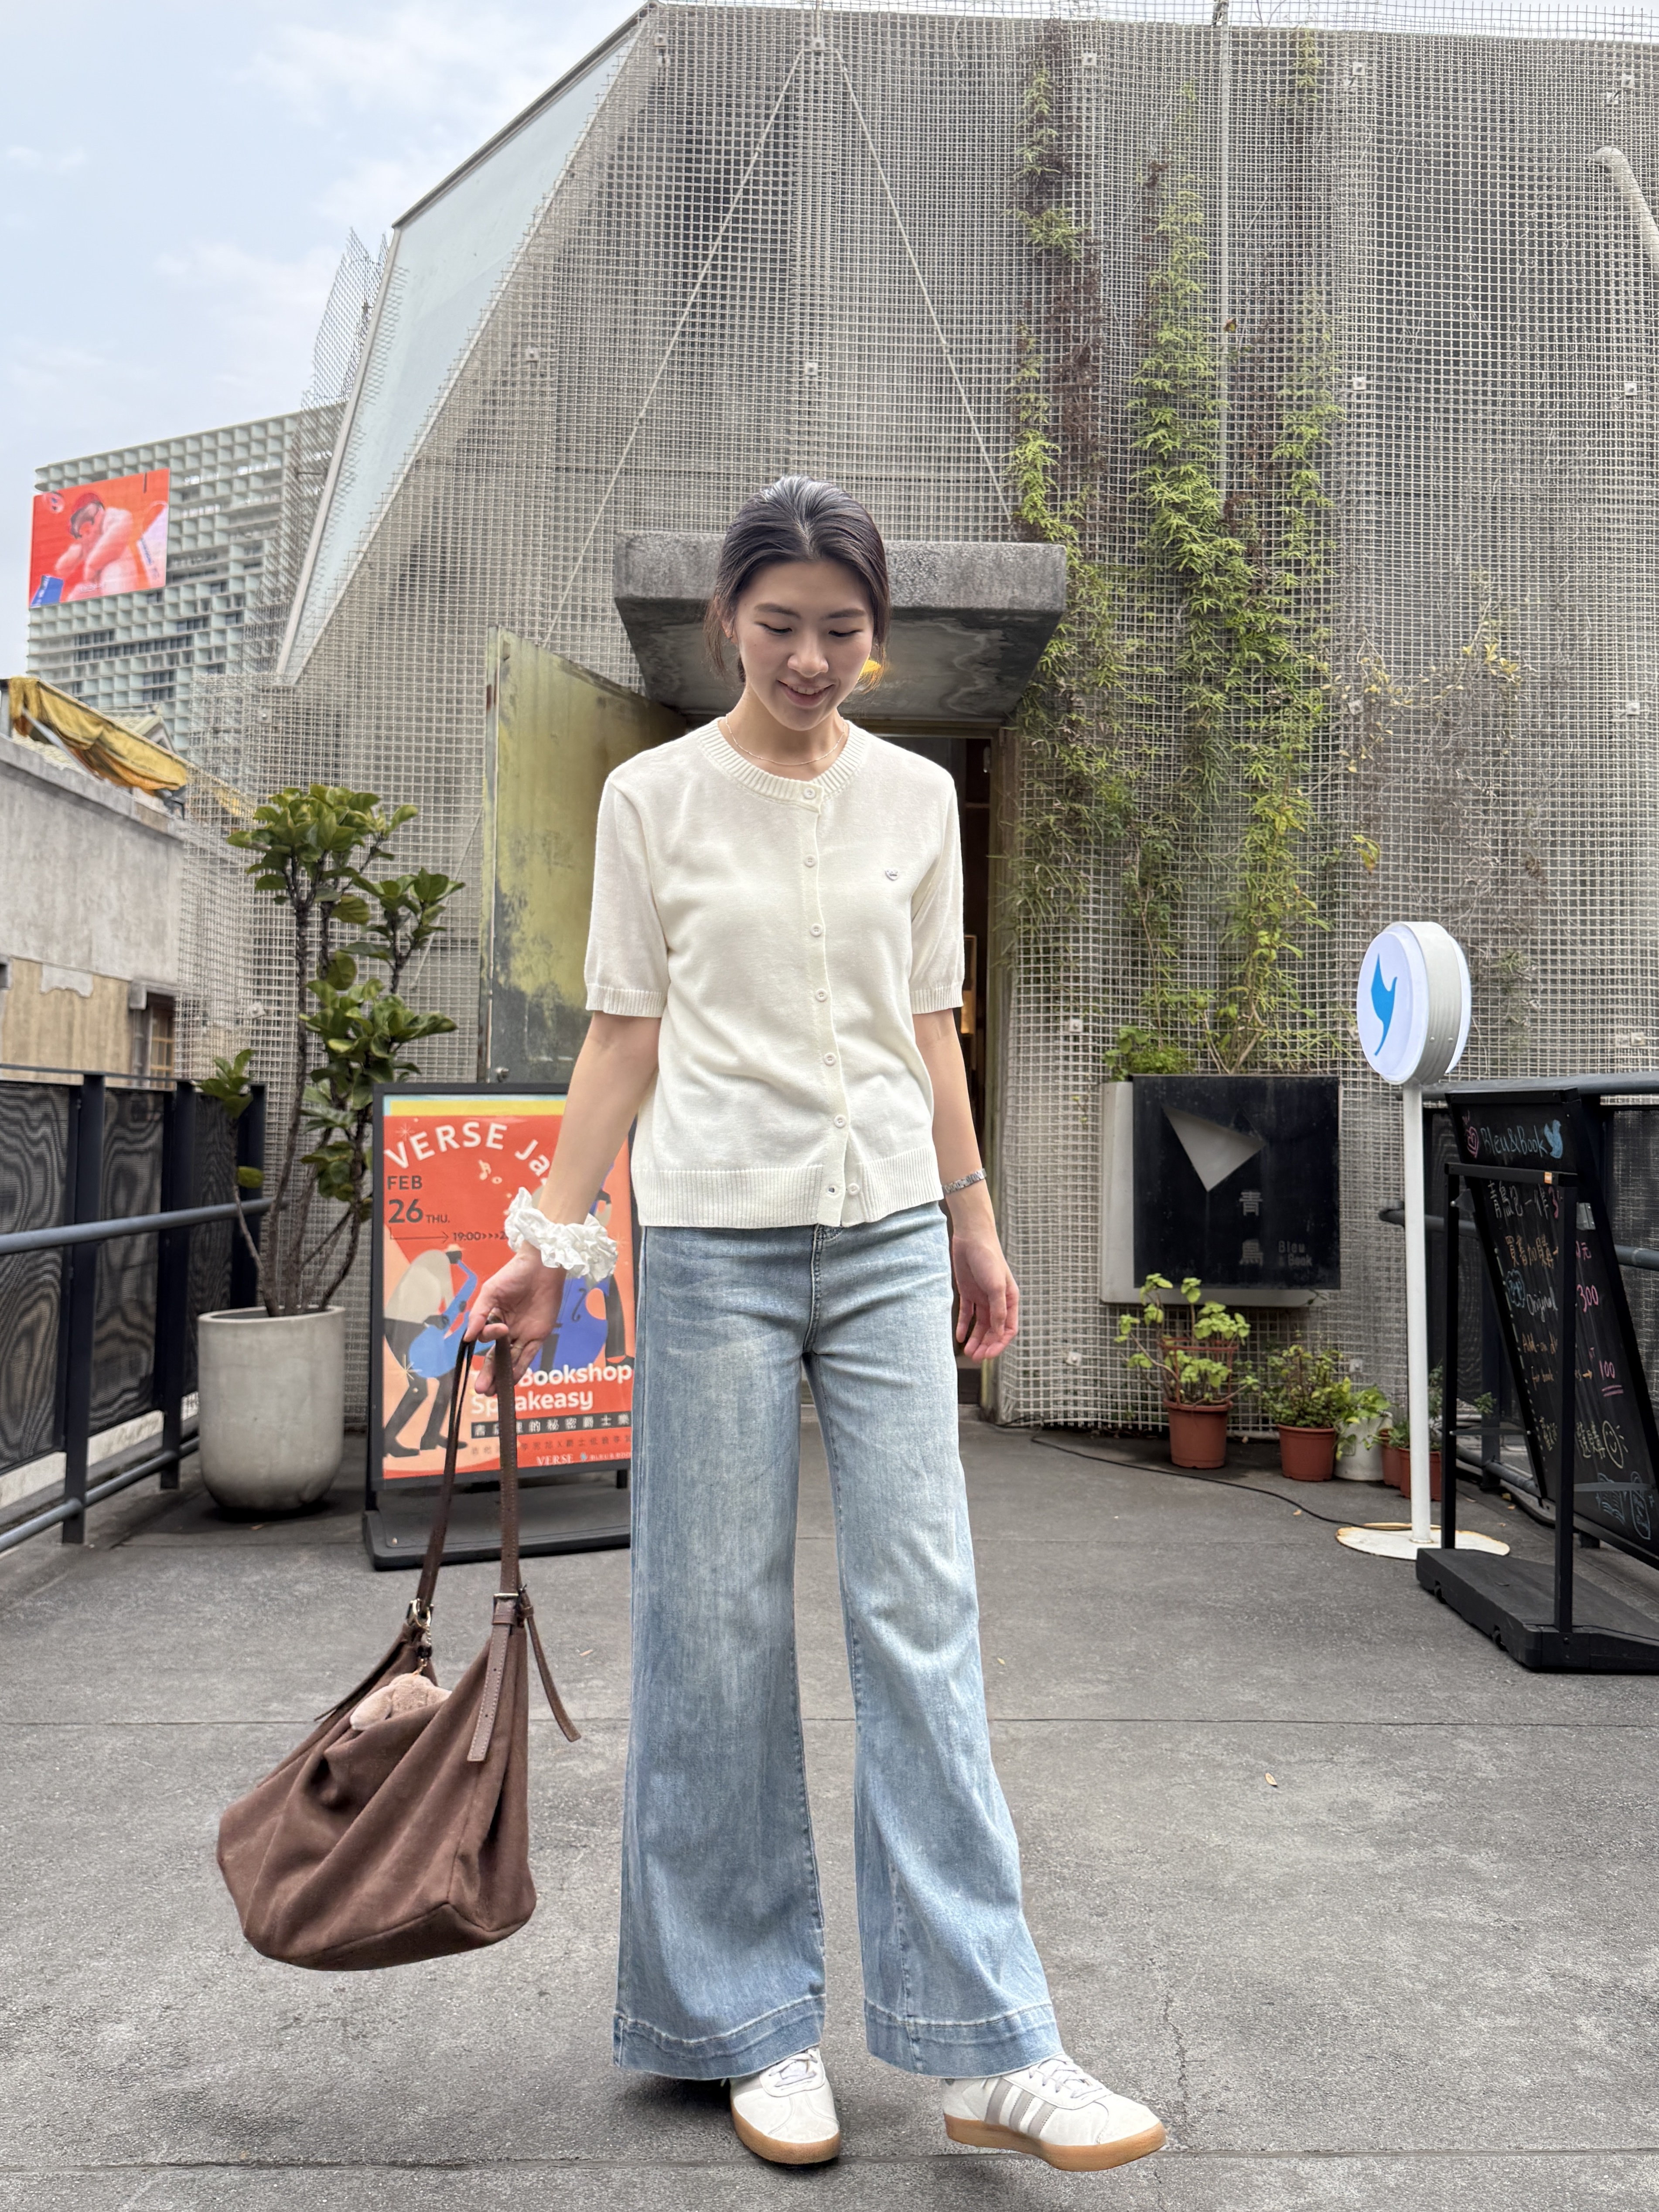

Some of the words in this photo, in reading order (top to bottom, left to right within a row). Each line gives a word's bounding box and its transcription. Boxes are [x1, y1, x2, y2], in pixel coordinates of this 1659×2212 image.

[384, 1121, 507, 1169] VERSE
[514, 1139, 550, 1187] Ja
[387, 1175, 423, 1190] FEB
[388, 1198, 424, 1224] 26
[426, 1214, 450, 1224] THU.
[1239, 1191, 1263, 1267] 青鳥
[1278, 1240, 1305, 1253] Bleu
[1287, 1253, 1313, 1267] Book
[1576, 1284, 1599, 1313] 300
[518, 1363, 632, 1387] Bookshop
[1599, 1360, 1616, 1380] 100
[471, 1391, 593, 1417] Spakeasy
[536, 1454, 574, 1467] VERSE
